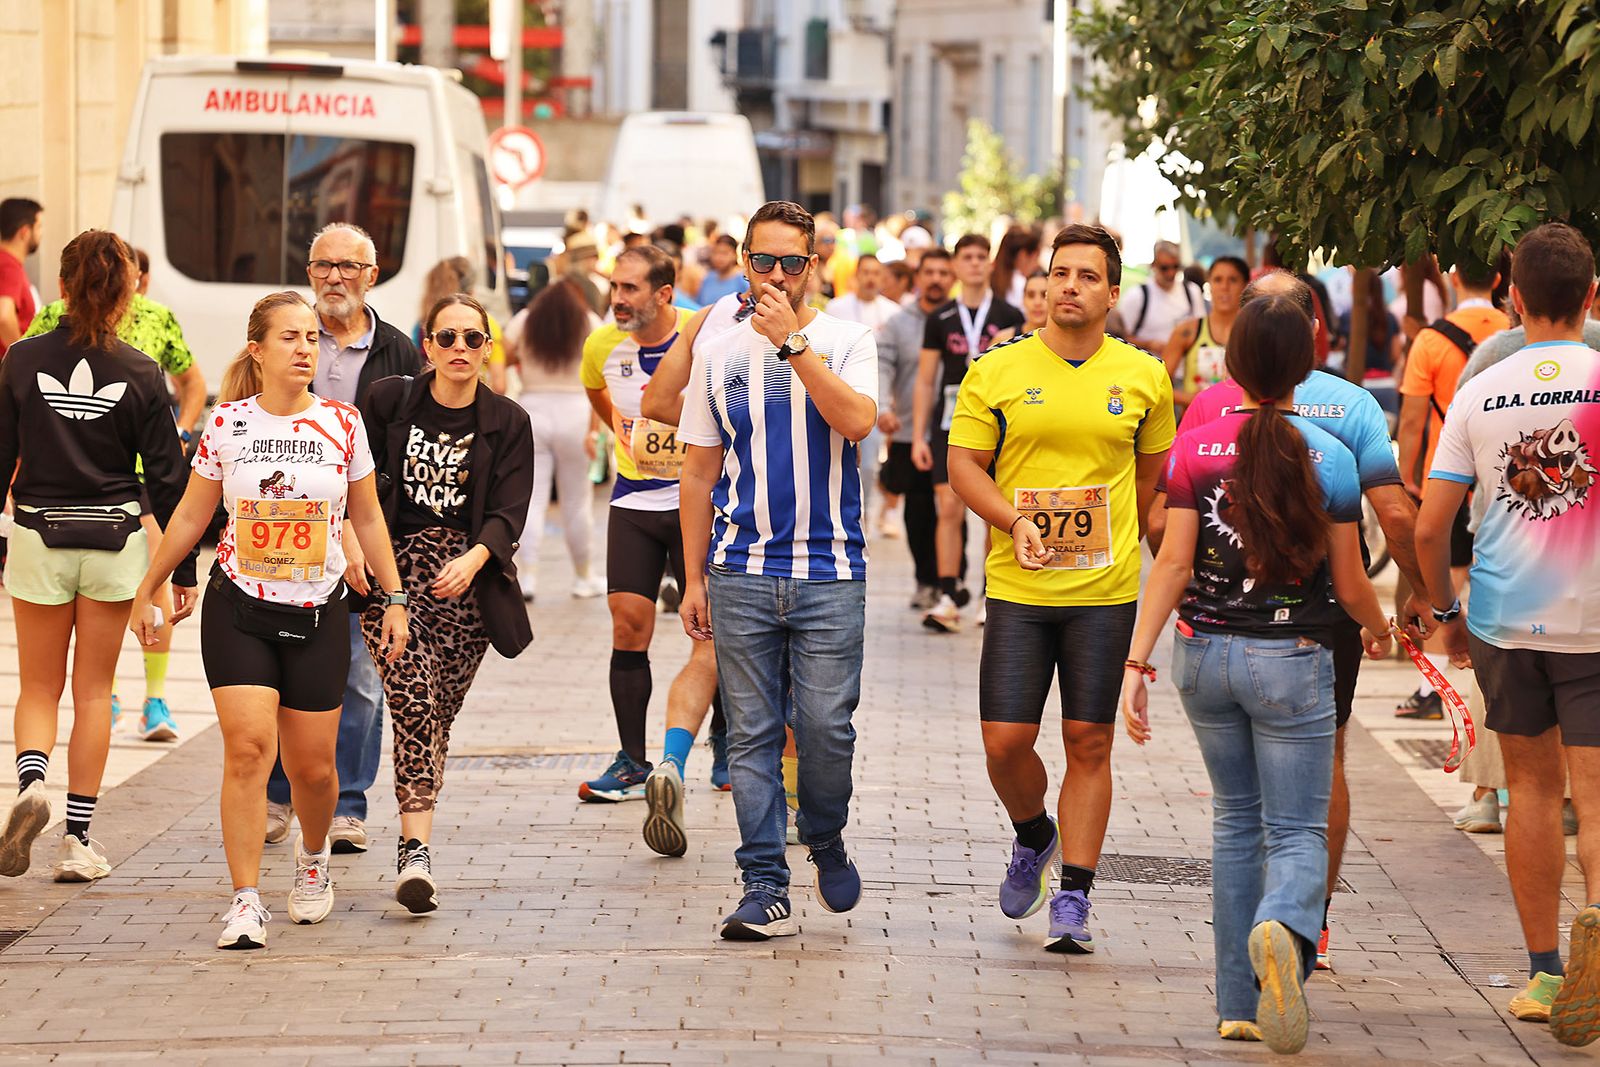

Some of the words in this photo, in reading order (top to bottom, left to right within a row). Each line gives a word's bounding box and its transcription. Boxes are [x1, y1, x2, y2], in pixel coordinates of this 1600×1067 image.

[204, 87, 376, 117] AMBULANCIA
[1483, 393, 1525, 412] C.D.A.
[252, 439, 323, 455] GUERRERAS
[406, 440, 462, 467] GIVE
[403, 458, 457, 485] LOVE
[251, 521, 312, 550] 978
[1033, 510, 1092, 539] 979
[240, 559, 278, 575] Huelva
[263, 556, 295, 565] GOMEZ
